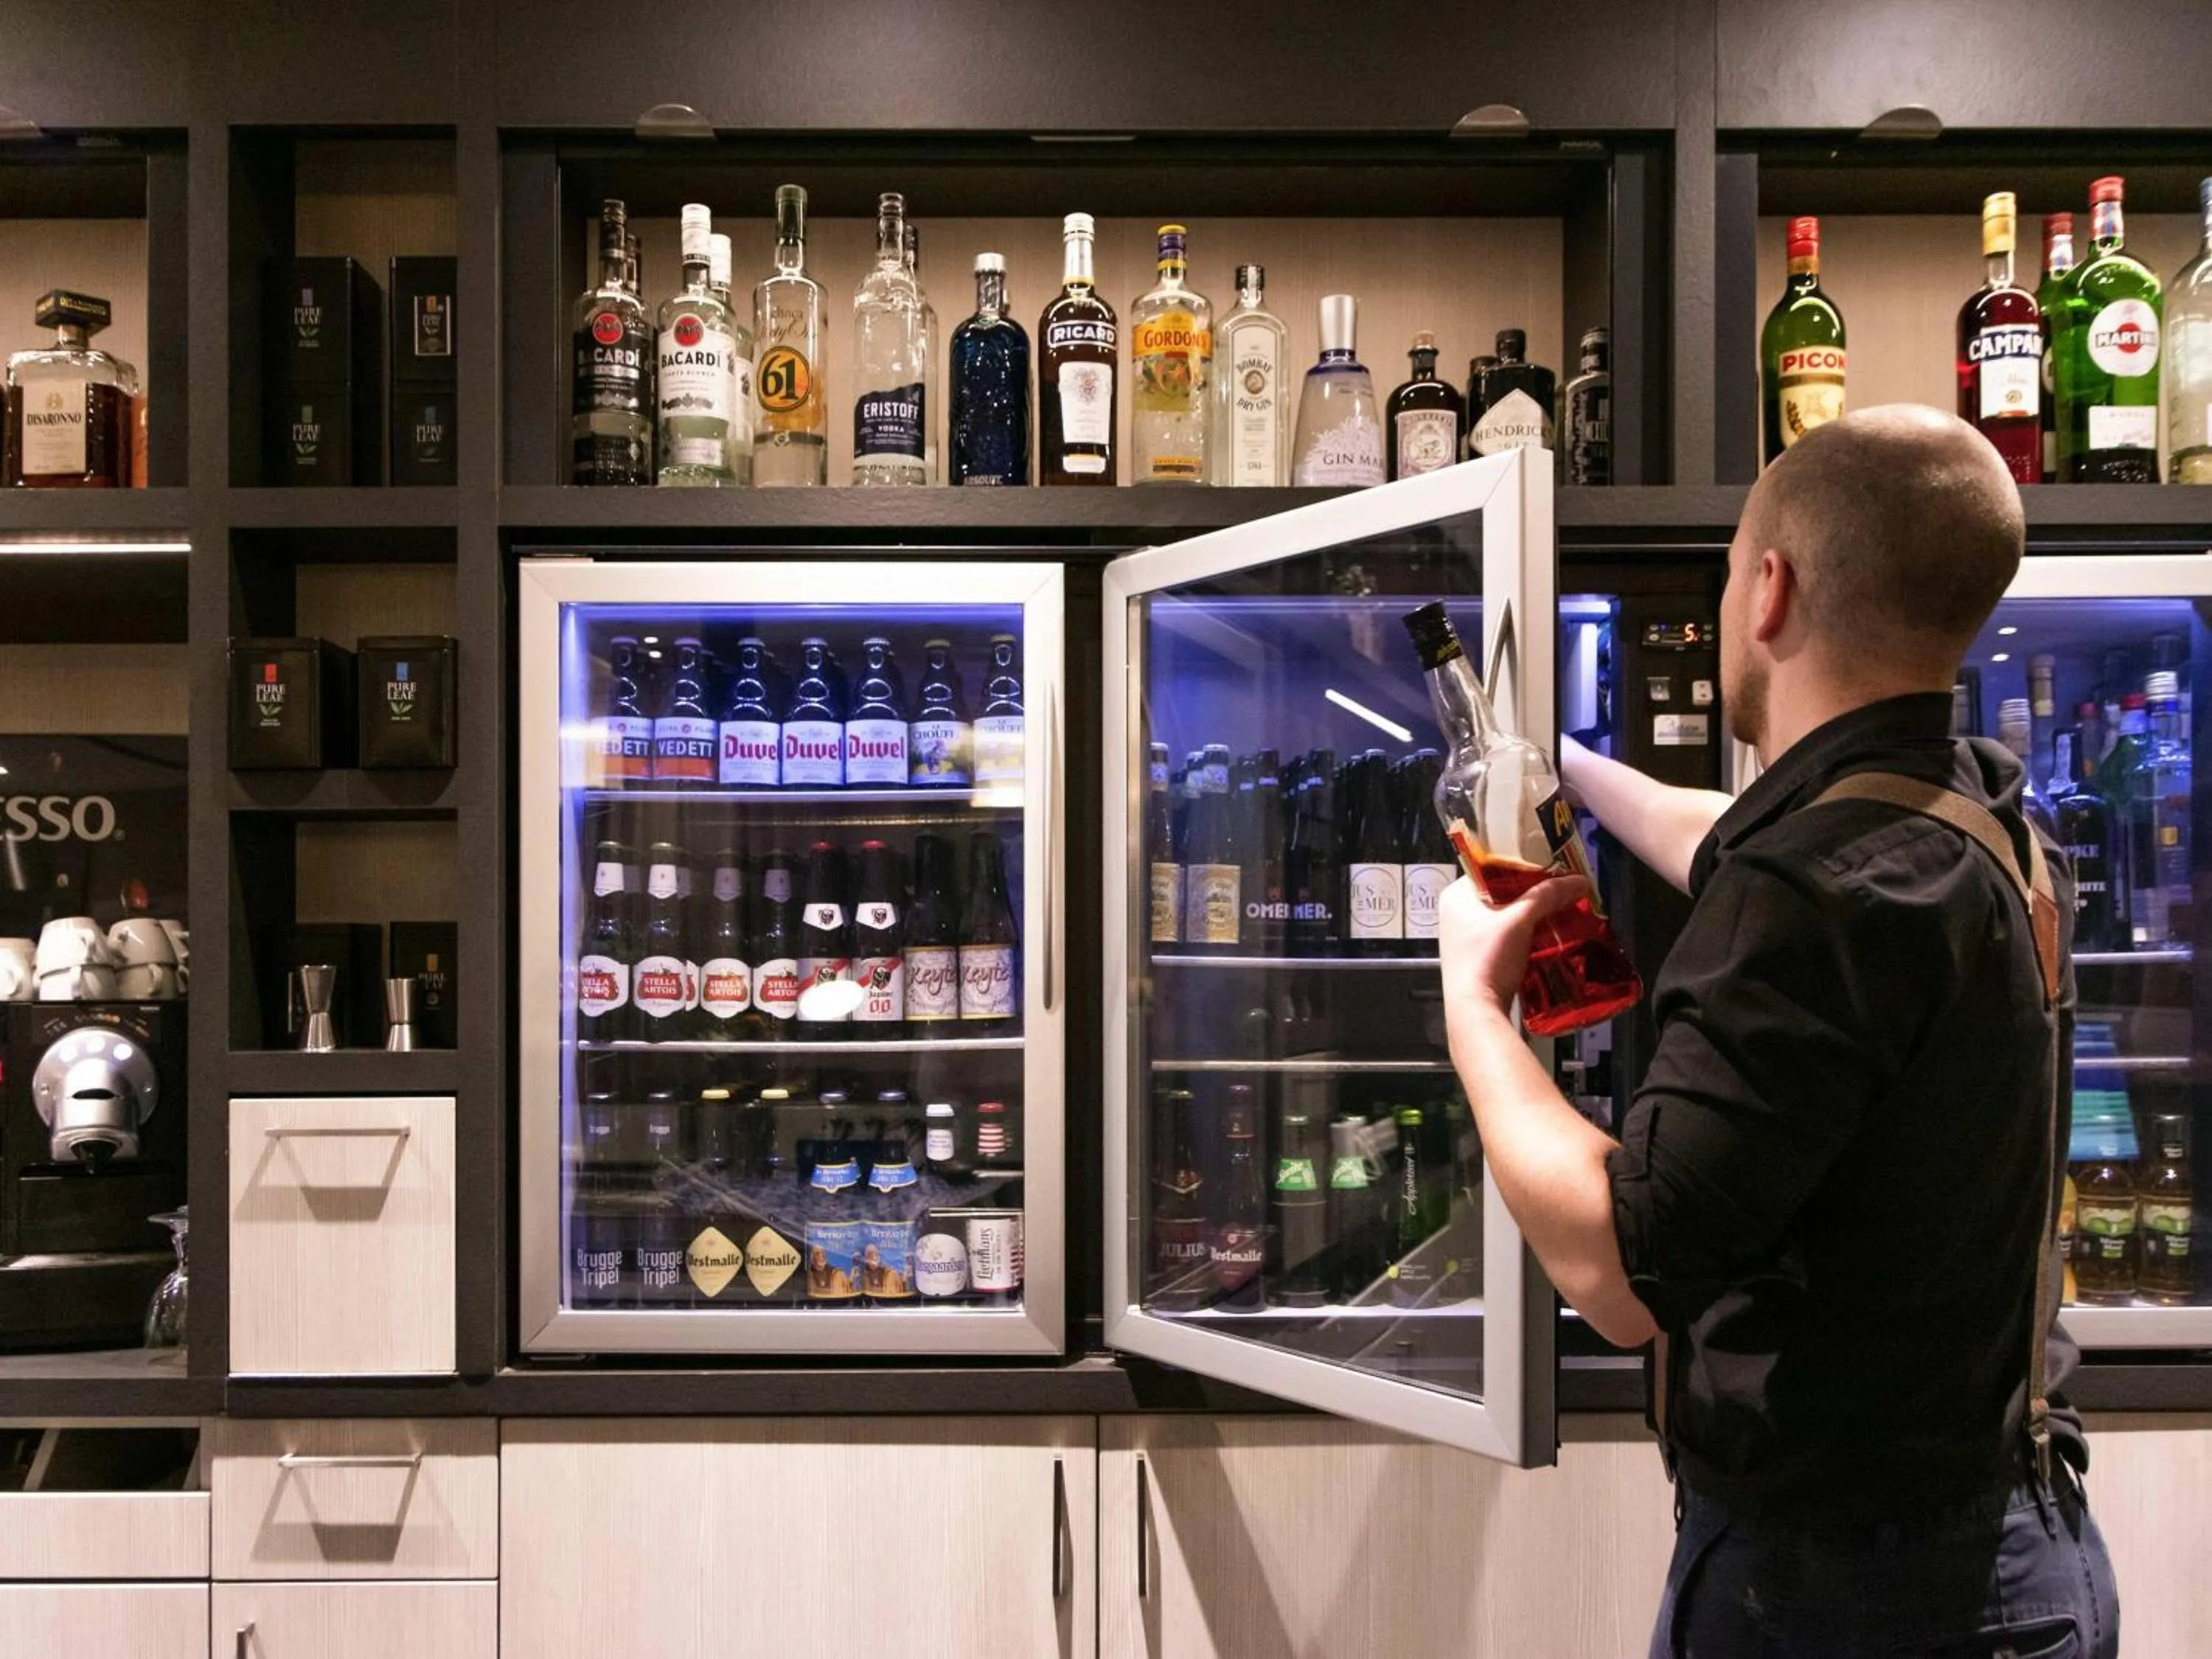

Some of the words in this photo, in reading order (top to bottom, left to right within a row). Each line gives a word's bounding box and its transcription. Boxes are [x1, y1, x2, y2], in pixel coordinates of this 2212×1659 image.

[1054, 325, 1114, 342] RICARD
[762, 355, 799, 400] 61
[27, 413, 82, 426] DISARONNO
[863, 402, 919, 420] ERISTOFF
[1323, 453, 1354, 465] GIN
[257, 684, 285, 693] PURE
[387, 682, 416, 692] PURE
[387, 691, 414, 700] LEAF
[257, 692, 283, 702] LEAF
[658, 739, 714, 757] VEDETT
[786, 734, 842, 760] Duvel
[849, 734, 905, 760] Duvel
[0, 795, 116, 842] SSO
[644, 978, 676, 987] STELLA
[644, 986, 676, 995] ARTOIS
[709, 980, 740, 989] STELLA
[709, 987, 742, 996] ARTOIS
[577, 1248, 623, 1270] Brugge
[637, 1248, 684, 1270] Brugge
[582, 1265, 619, 1289] Tripel
[643, 1265, 680, 1289] Tripel
